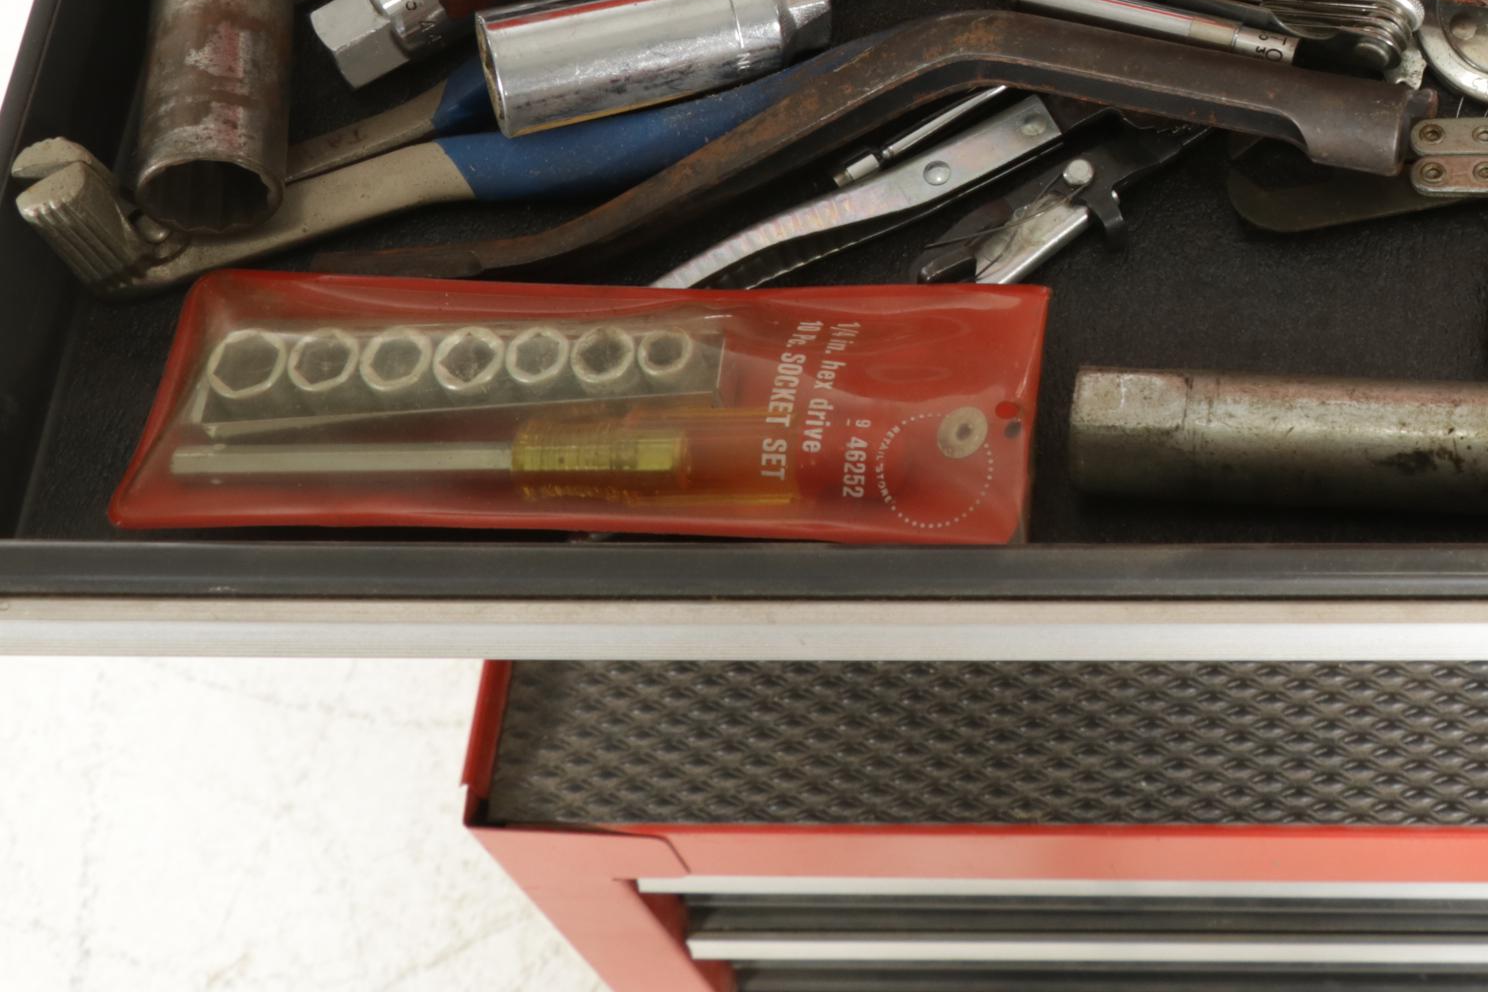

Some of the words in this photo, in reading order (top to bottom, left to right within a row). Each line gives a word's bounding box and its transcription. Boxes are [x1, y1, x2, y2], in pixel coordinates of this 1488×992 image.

[765, 351, 807, 428] SOCKET
[814, 360, 847, 390] hex
[801, 398, 834, 454] drive
[760, 437, 788, 481] SET
[842, 435, 870, 499] 46252
